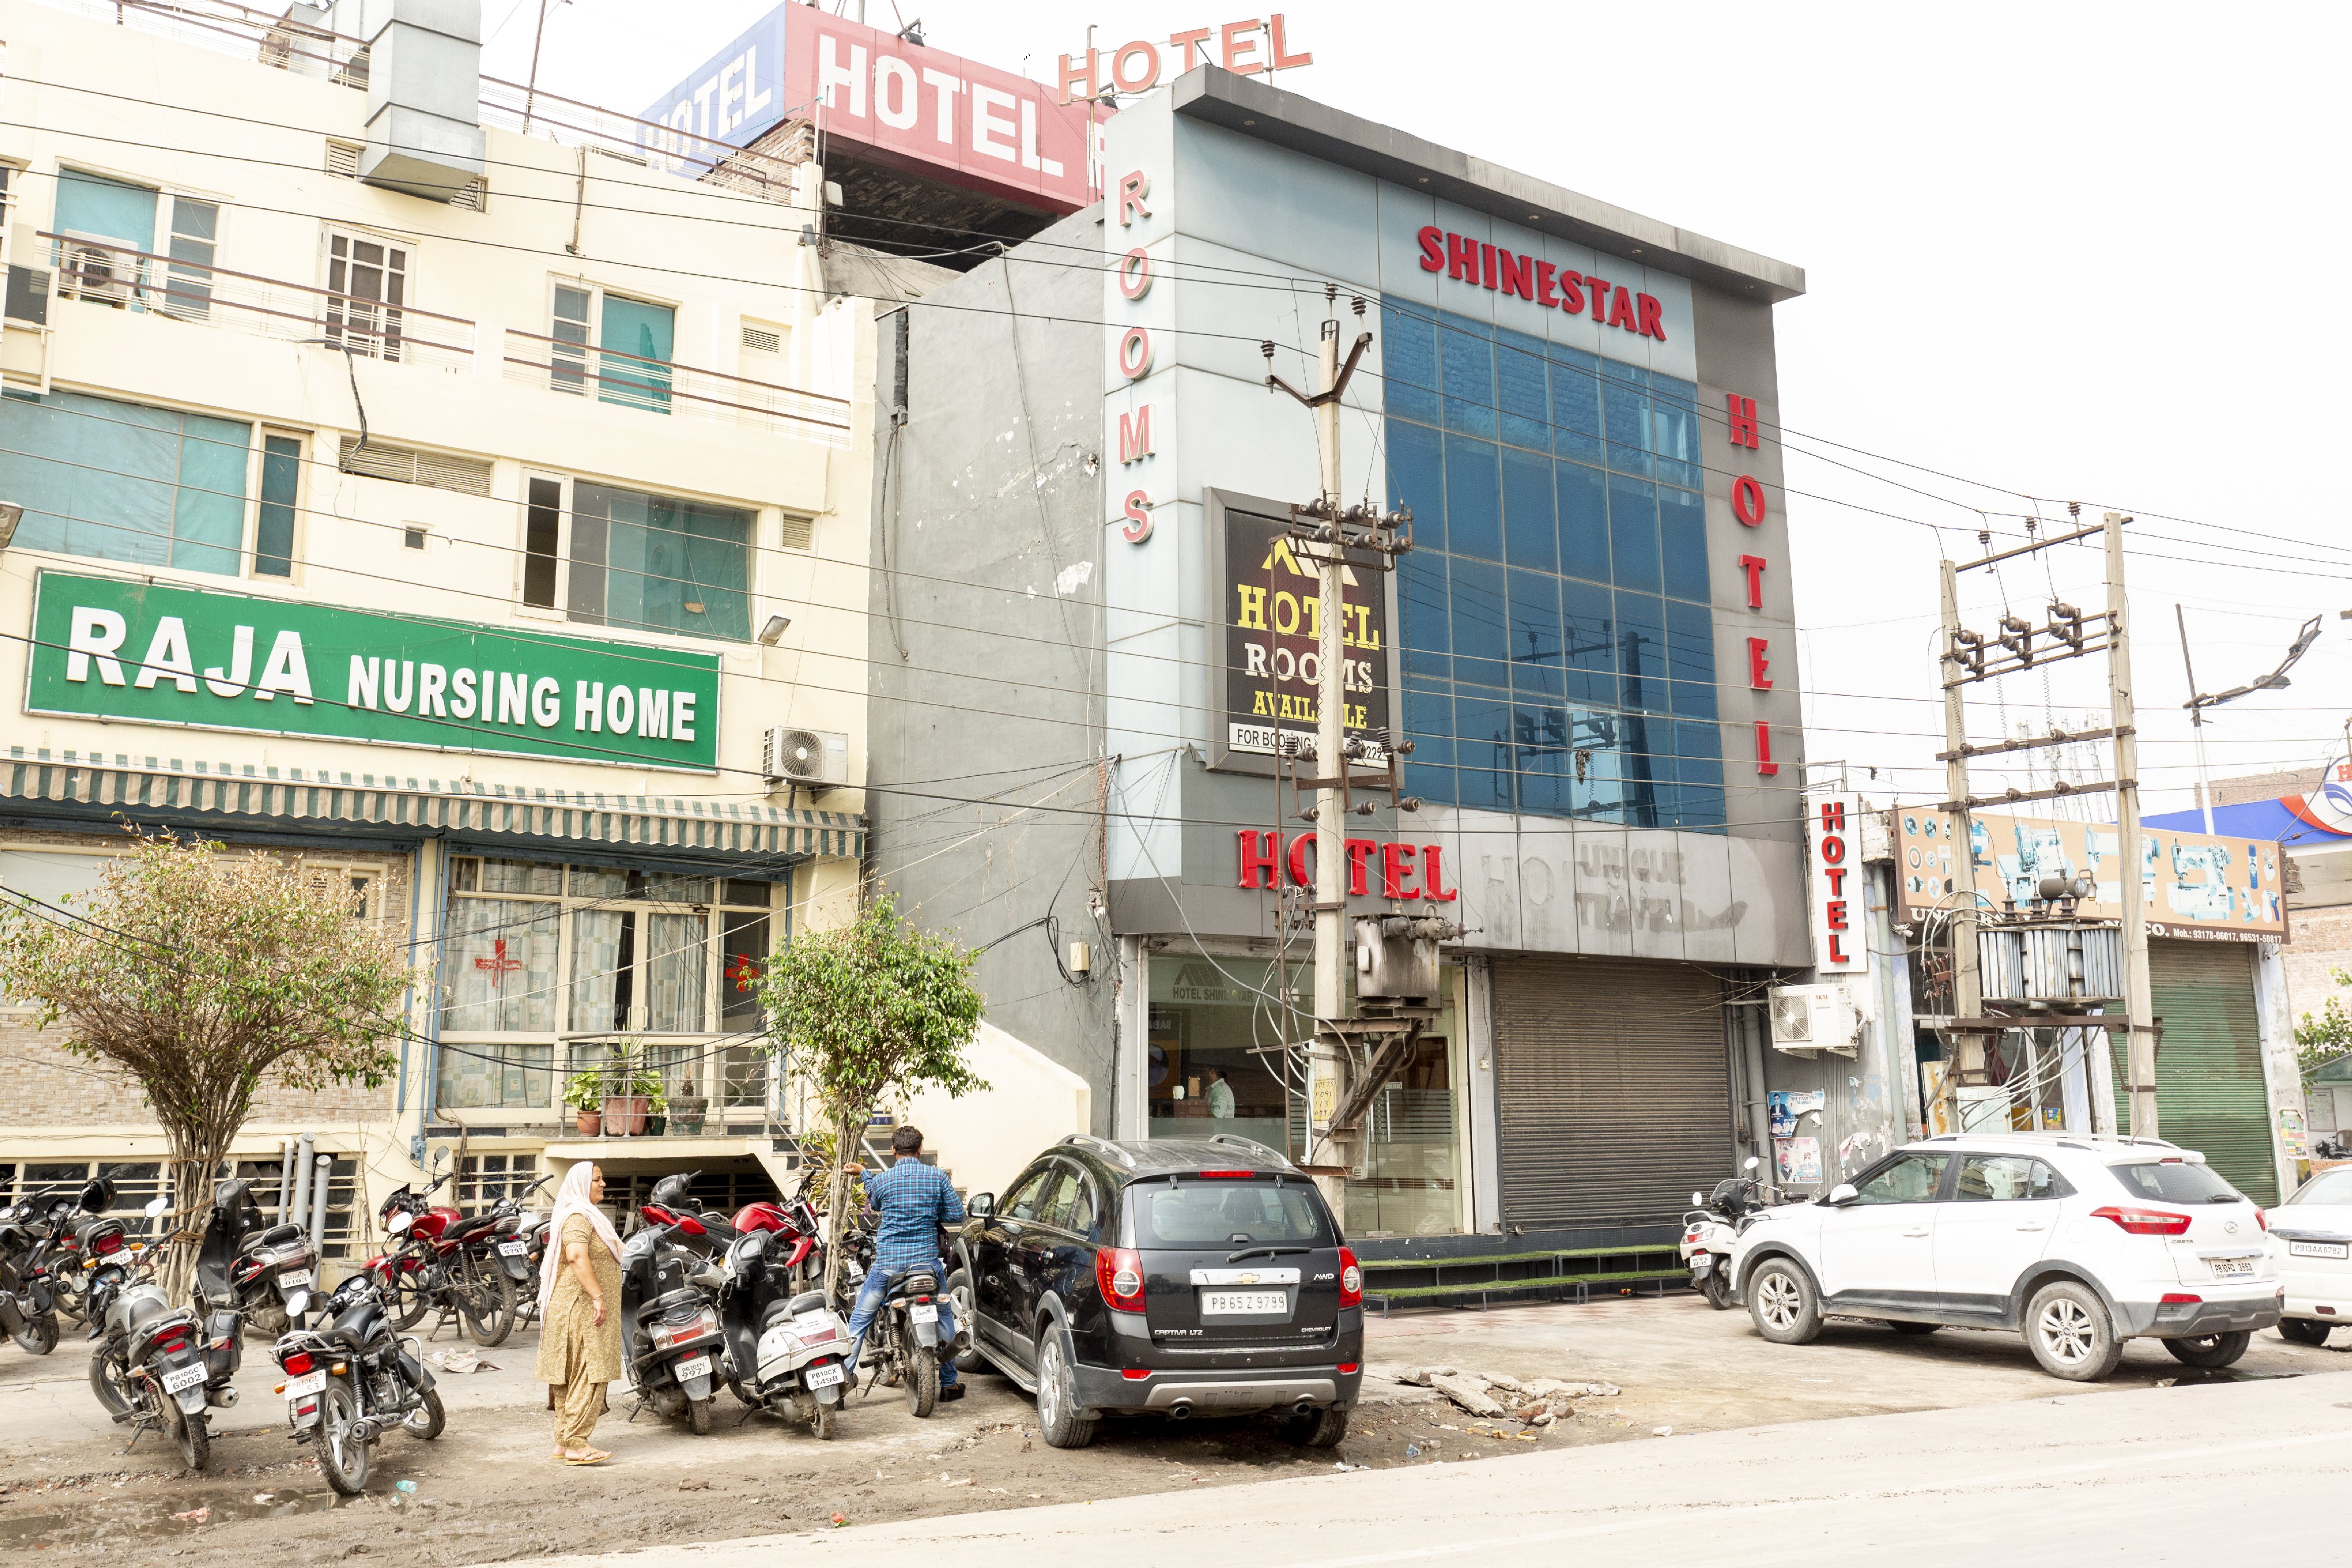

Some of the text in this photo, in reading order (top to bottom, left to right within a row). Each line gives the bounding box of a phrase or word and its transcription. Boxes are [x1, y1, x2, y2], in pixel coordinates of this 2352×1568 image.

[819, 33, 1064, 178] HOTEL
[1058, 13, 1313, 107] HOTEL
[645, 44, 771, 173] HOTEL
[1417, 225, 1667, 341] SHINESTAR
[1119, 169, 1155, 544] ROOMS
[1727, 393, 1778, 776] HOTEL
[65, 605, 696, 742] RAJA NURSING HOME
[1253, 691, 1367, 729] AVAILLE
[1238, 729, 1312, 749] FOR BOONG
[1238, 830, 1458, 902] HOTEL
[1821, 802, 1850, 963] HOTEL
[1173, 986, 1202, 1000] HOTEL
[1212, 1297, 1226, 1310] PB
[1229, 1297, 1243, 1309] 65
[1257, 1296, 1285, 1309] 9799
[173, 1374, 202, 1390] 6002
[813, 1376, 839, 1387] 3498
